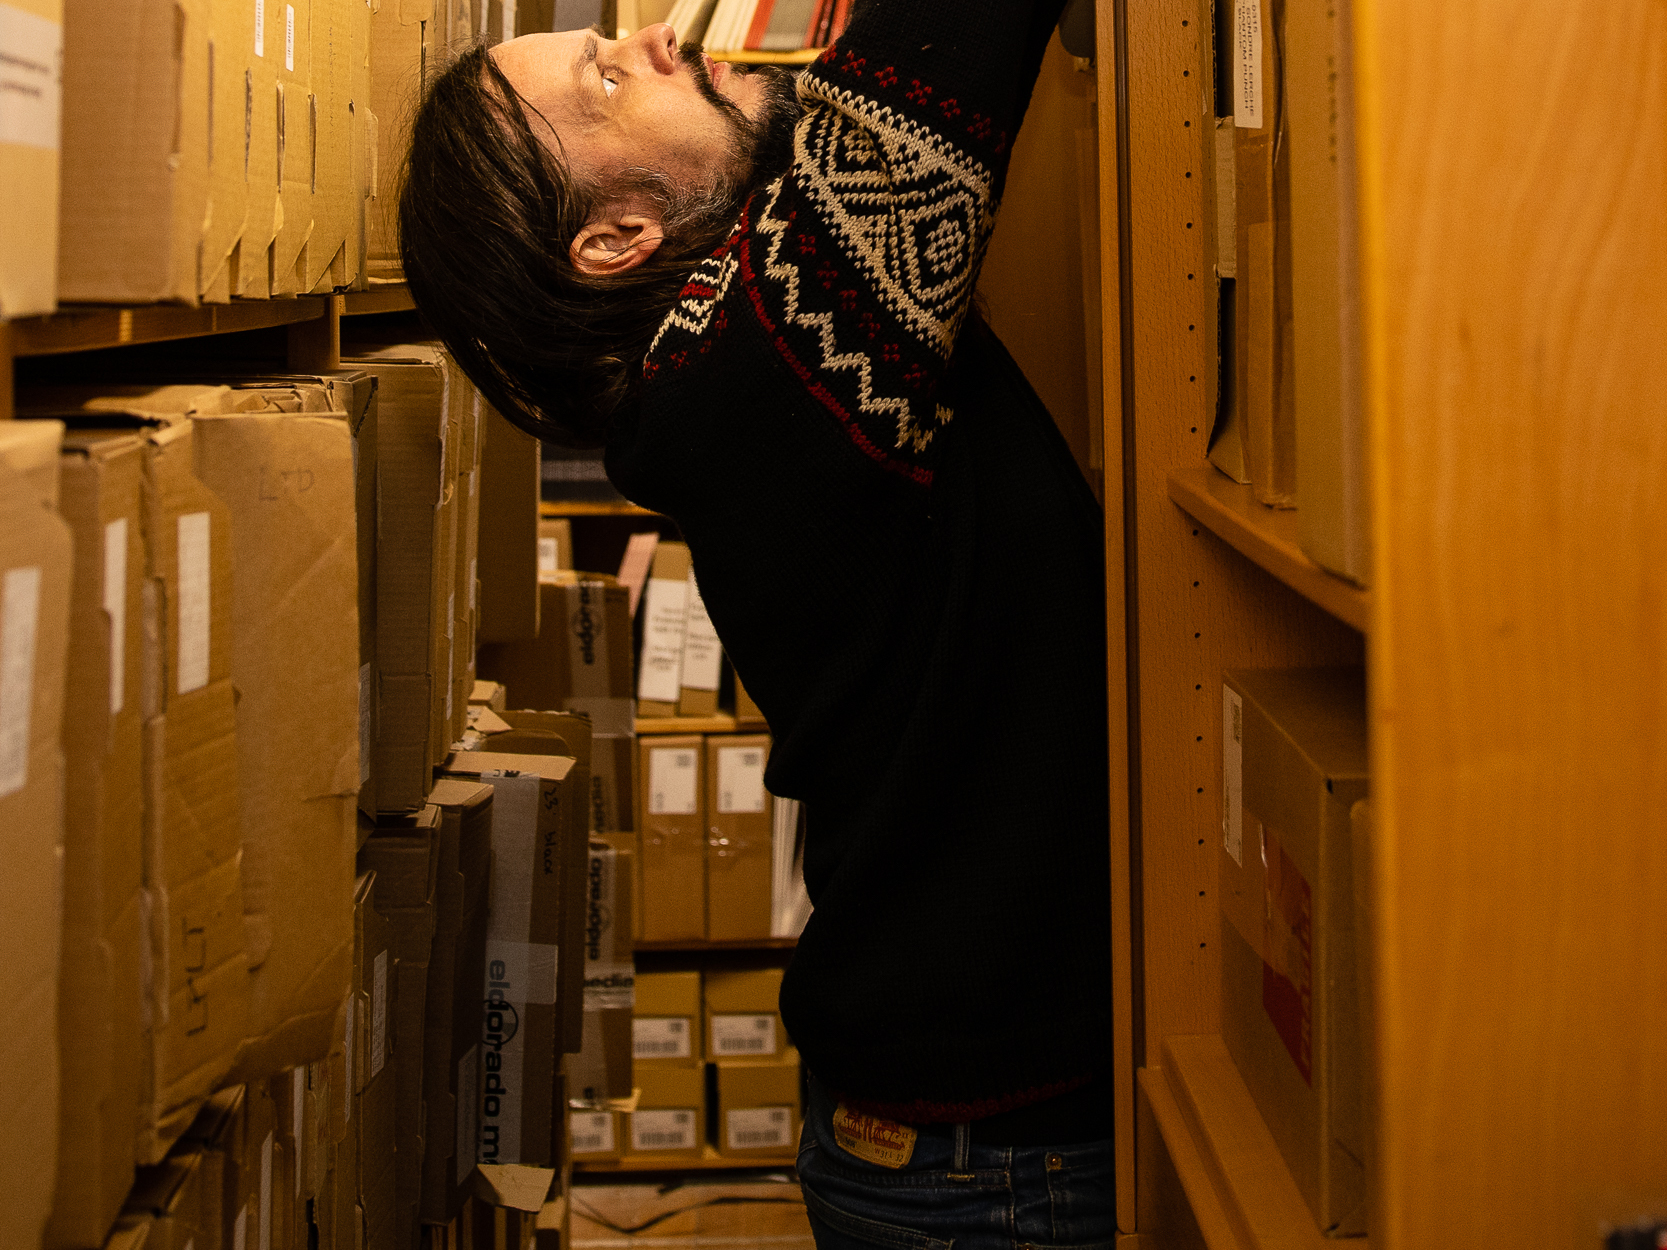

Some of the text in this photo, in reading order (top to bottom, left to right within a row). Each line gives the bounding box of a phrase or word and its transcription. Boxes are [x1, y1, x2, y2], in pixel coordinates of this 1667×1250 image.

[577, 586, 594, 666] eldora
[585, 857, 602, 963] eldorado
[482, 959, 511, 1165] eldorado m
